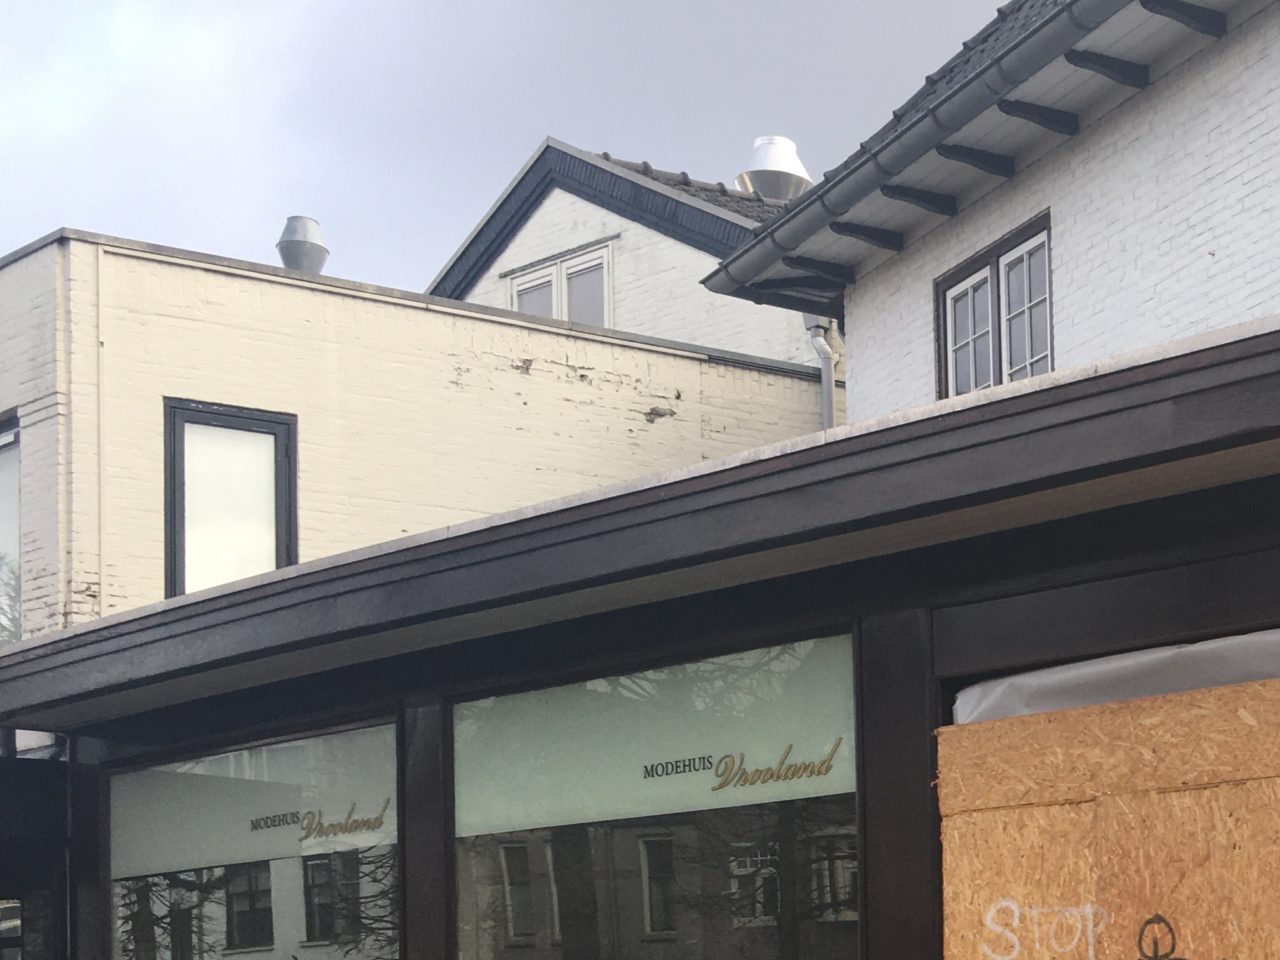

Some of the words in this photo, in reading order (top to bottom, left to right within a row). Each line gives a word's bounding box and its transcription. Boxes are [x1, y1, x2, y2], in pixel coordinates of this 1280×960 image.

[643, 754, 714, 779] MODEHUIS
[711, 736, 843, 792] Vrooland
[249, 810, 300, 832] MODEHUIS
